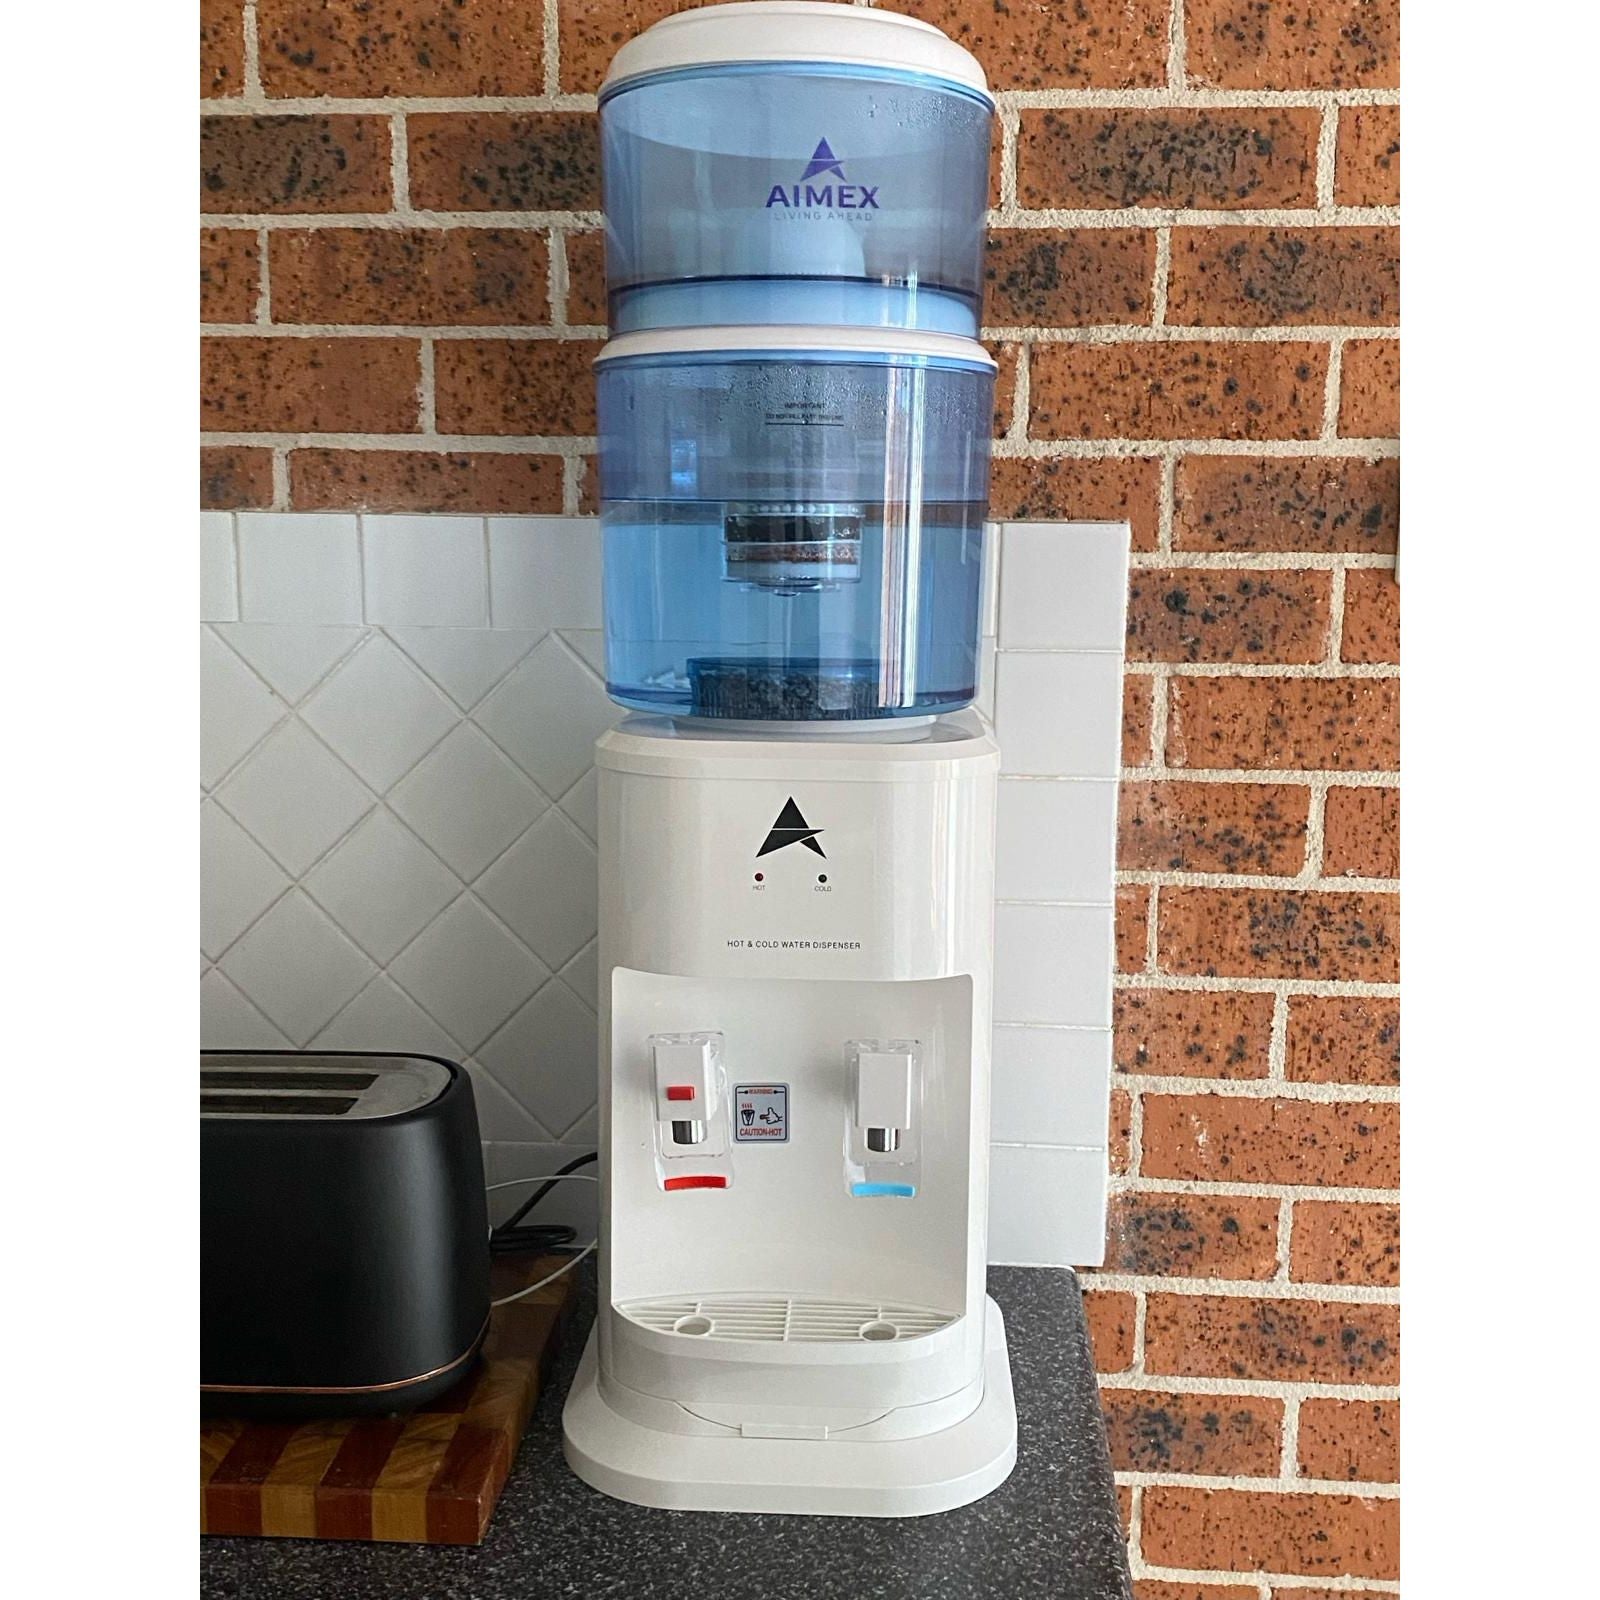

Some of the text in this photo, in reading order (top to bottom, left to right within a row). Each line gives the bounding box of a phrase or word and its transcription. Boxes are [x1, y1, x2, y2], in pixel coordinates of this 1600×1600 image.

[765, 185, 880, 209] AIMEX
[774, 212, 873, 221] LIVING AHEAD
[727, 940, 861, 949] HOT & COLD WATER DISPENSER
